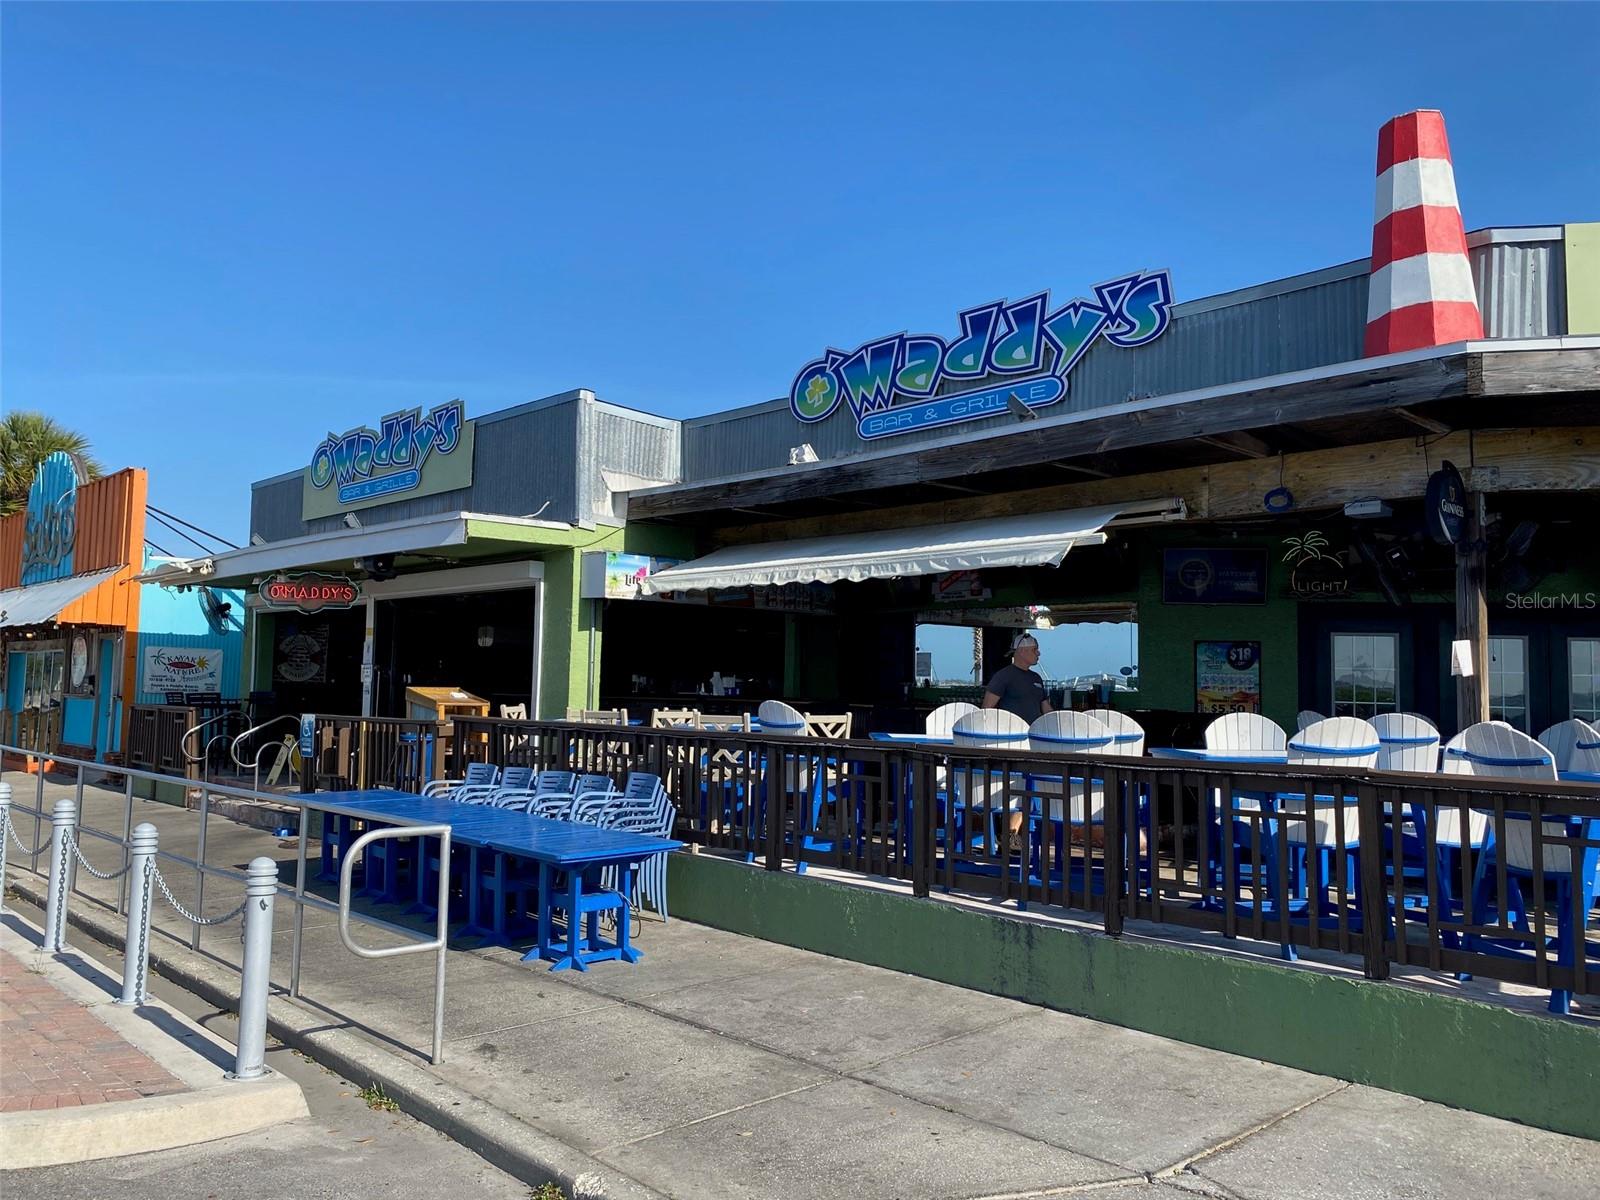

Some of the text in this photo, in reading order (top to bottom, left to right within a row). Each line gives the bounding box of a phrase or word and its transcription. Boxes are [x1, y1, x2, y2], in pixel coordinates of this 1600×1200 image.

[791, 271, 1172, 422] O'Maddy's
[869, 384, 1047, 432] BAR & GRILE
[312, 404, 460, 487] O'Maddy's
[342, 474, 414, 498] BAR & GRILLE
[1297, 581, 1343, 592] LIGHT
[163, 665, 201, 676] NATURE
[167, 655, 197, 663] KAYAK
